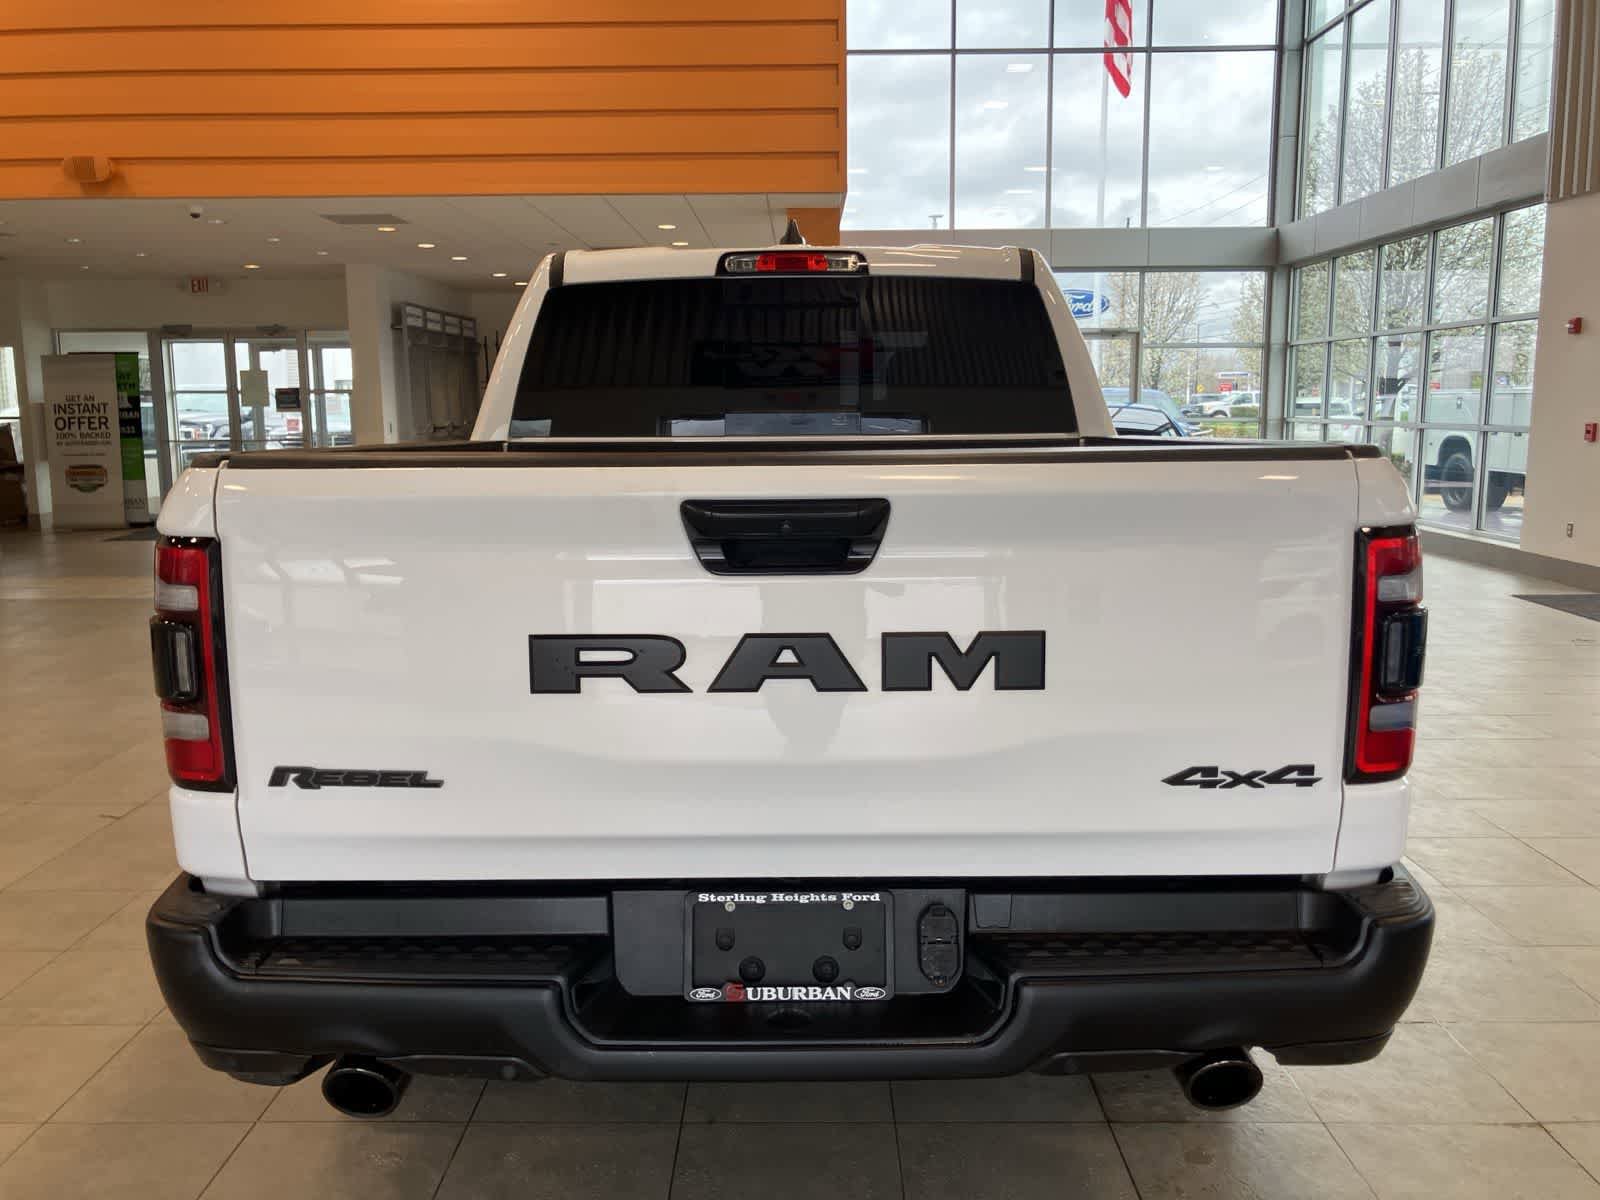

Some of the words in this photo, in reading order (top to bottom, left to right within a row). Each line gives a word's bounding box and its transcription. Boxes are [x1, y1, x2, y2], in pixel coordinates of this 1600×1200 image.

[191, 278, 209, 293] EXIT
[83, 393, 96, 402] AN
[53, 402, 109, 415] INSTANT
[54, 415, 110, 431] OFFER
[528, 630, 1046, 694] RAM
[268, 765, 444, 789] REBEL
[698, 893, 766, 904] Sterling
[771, 892, 837, 903] Heights
[841, 892, 880, 902] Ford
[694, 988, 718, 999] Ford
[724, 983, 852, 1001] SUBURBAN
[858, 988, 882, 999] Ford
